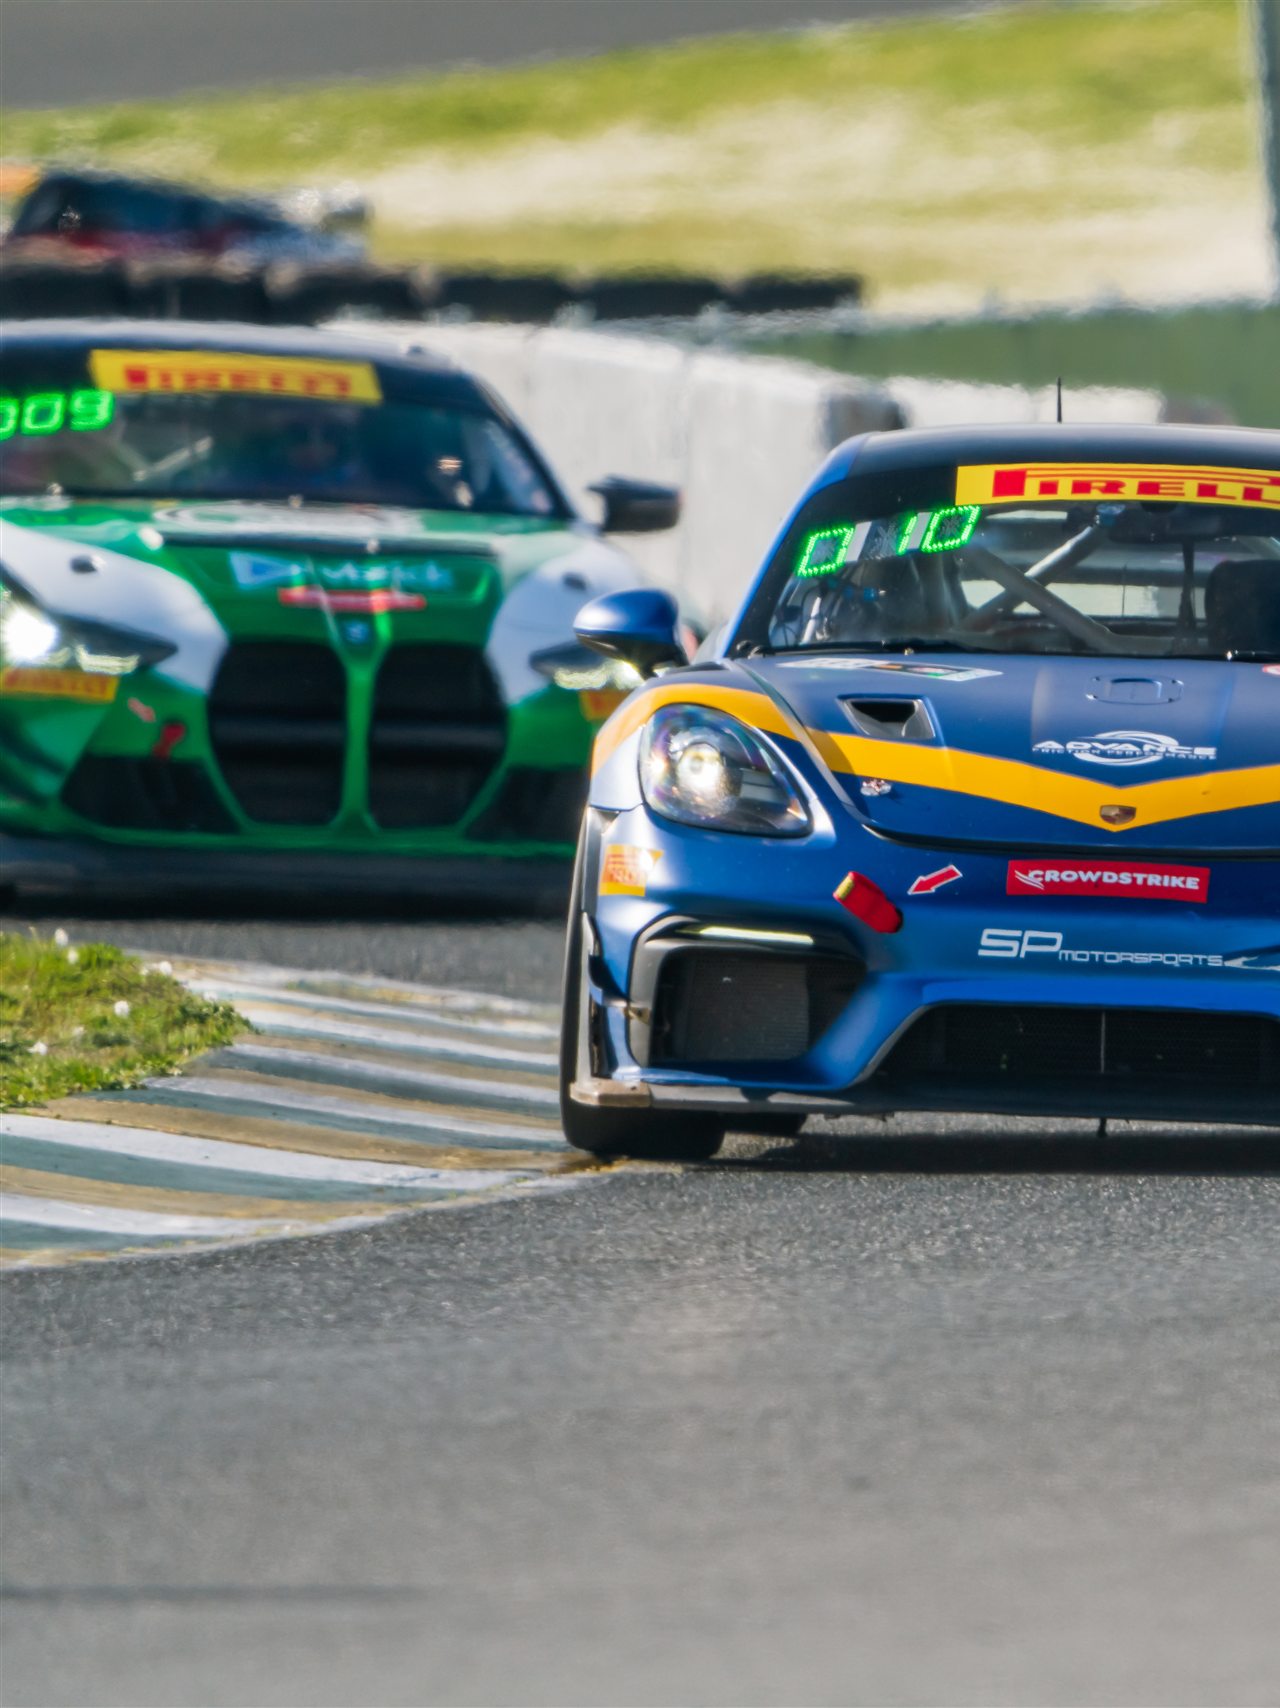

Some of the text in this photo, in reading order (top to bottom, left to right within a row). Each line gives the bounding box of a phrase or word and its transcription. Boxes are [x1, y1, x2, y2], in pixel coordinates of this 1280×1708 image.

[1033, 740, 1217, 756] ADVANCE
[1027, 869, 1200, 890] CROWDSTRIKE
[978, 928, 1222, 967] SP MOTORSPORTS
